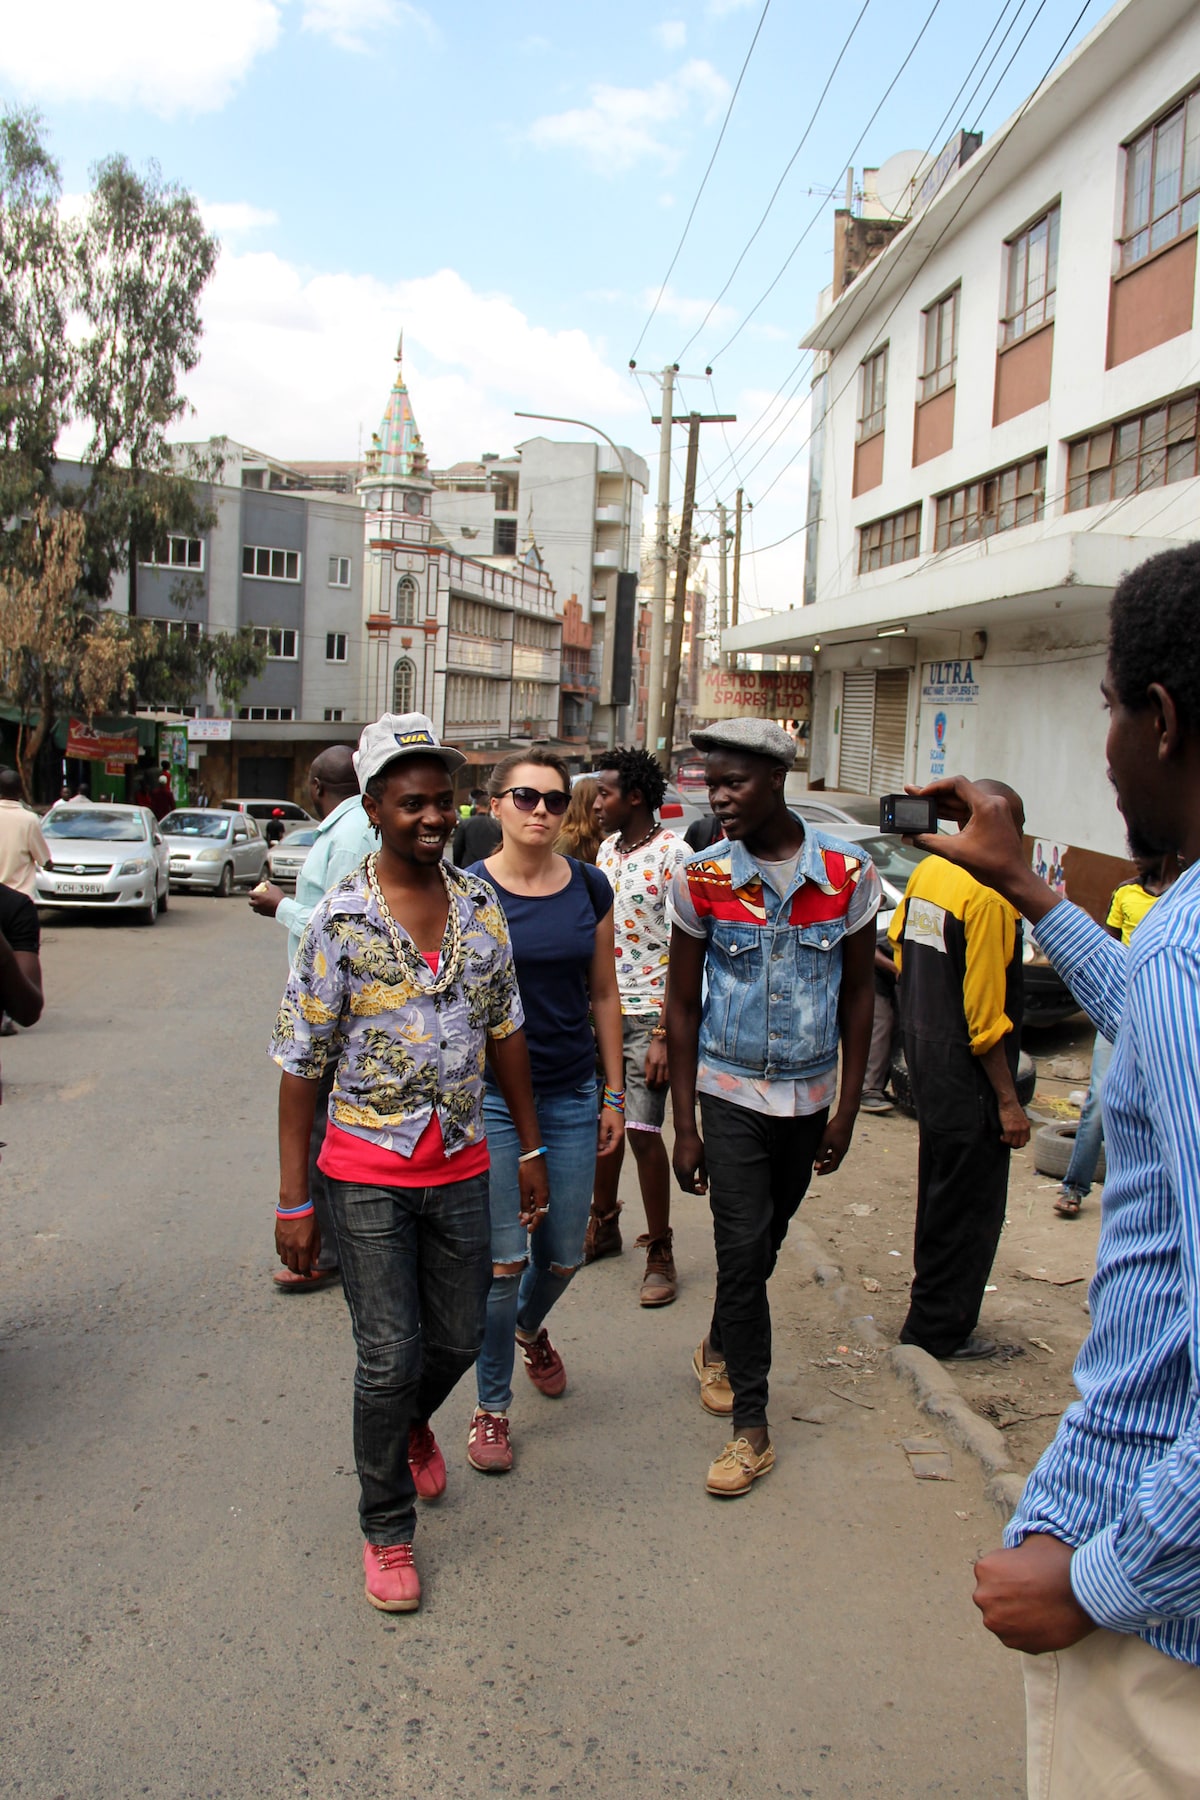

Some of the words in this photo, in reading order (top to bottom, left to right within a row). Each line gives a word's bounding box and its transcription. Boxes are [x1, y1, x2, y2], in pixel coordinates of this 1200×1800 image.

[929, 661, 975, 685] ULTRA
[704, 673, 757, 688] METRO
[760, 675, 810, 691] MOTOR
[713, 690, 768, 707] SPARES
[400, 733, 428, 744] VIA
